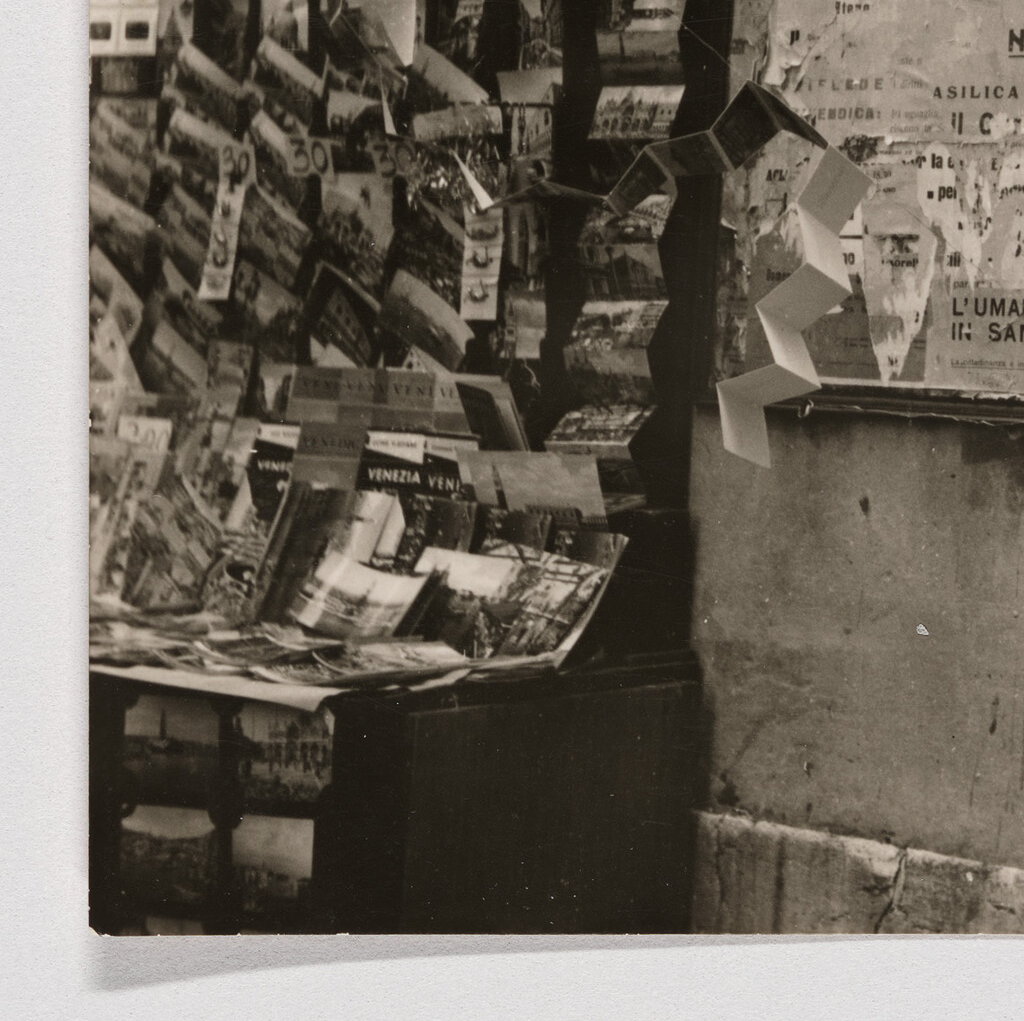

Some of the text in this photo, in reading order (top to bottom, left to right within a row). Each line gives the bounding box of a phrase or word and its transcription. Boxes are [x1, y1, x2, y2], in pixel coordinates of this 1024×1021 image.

[933, 85, 1019, 100] ASILICA
[292, 137, 329, 174] 30
[950, 323, 973, 342] IN
[368, 467, 422, 485] VENEZIA
